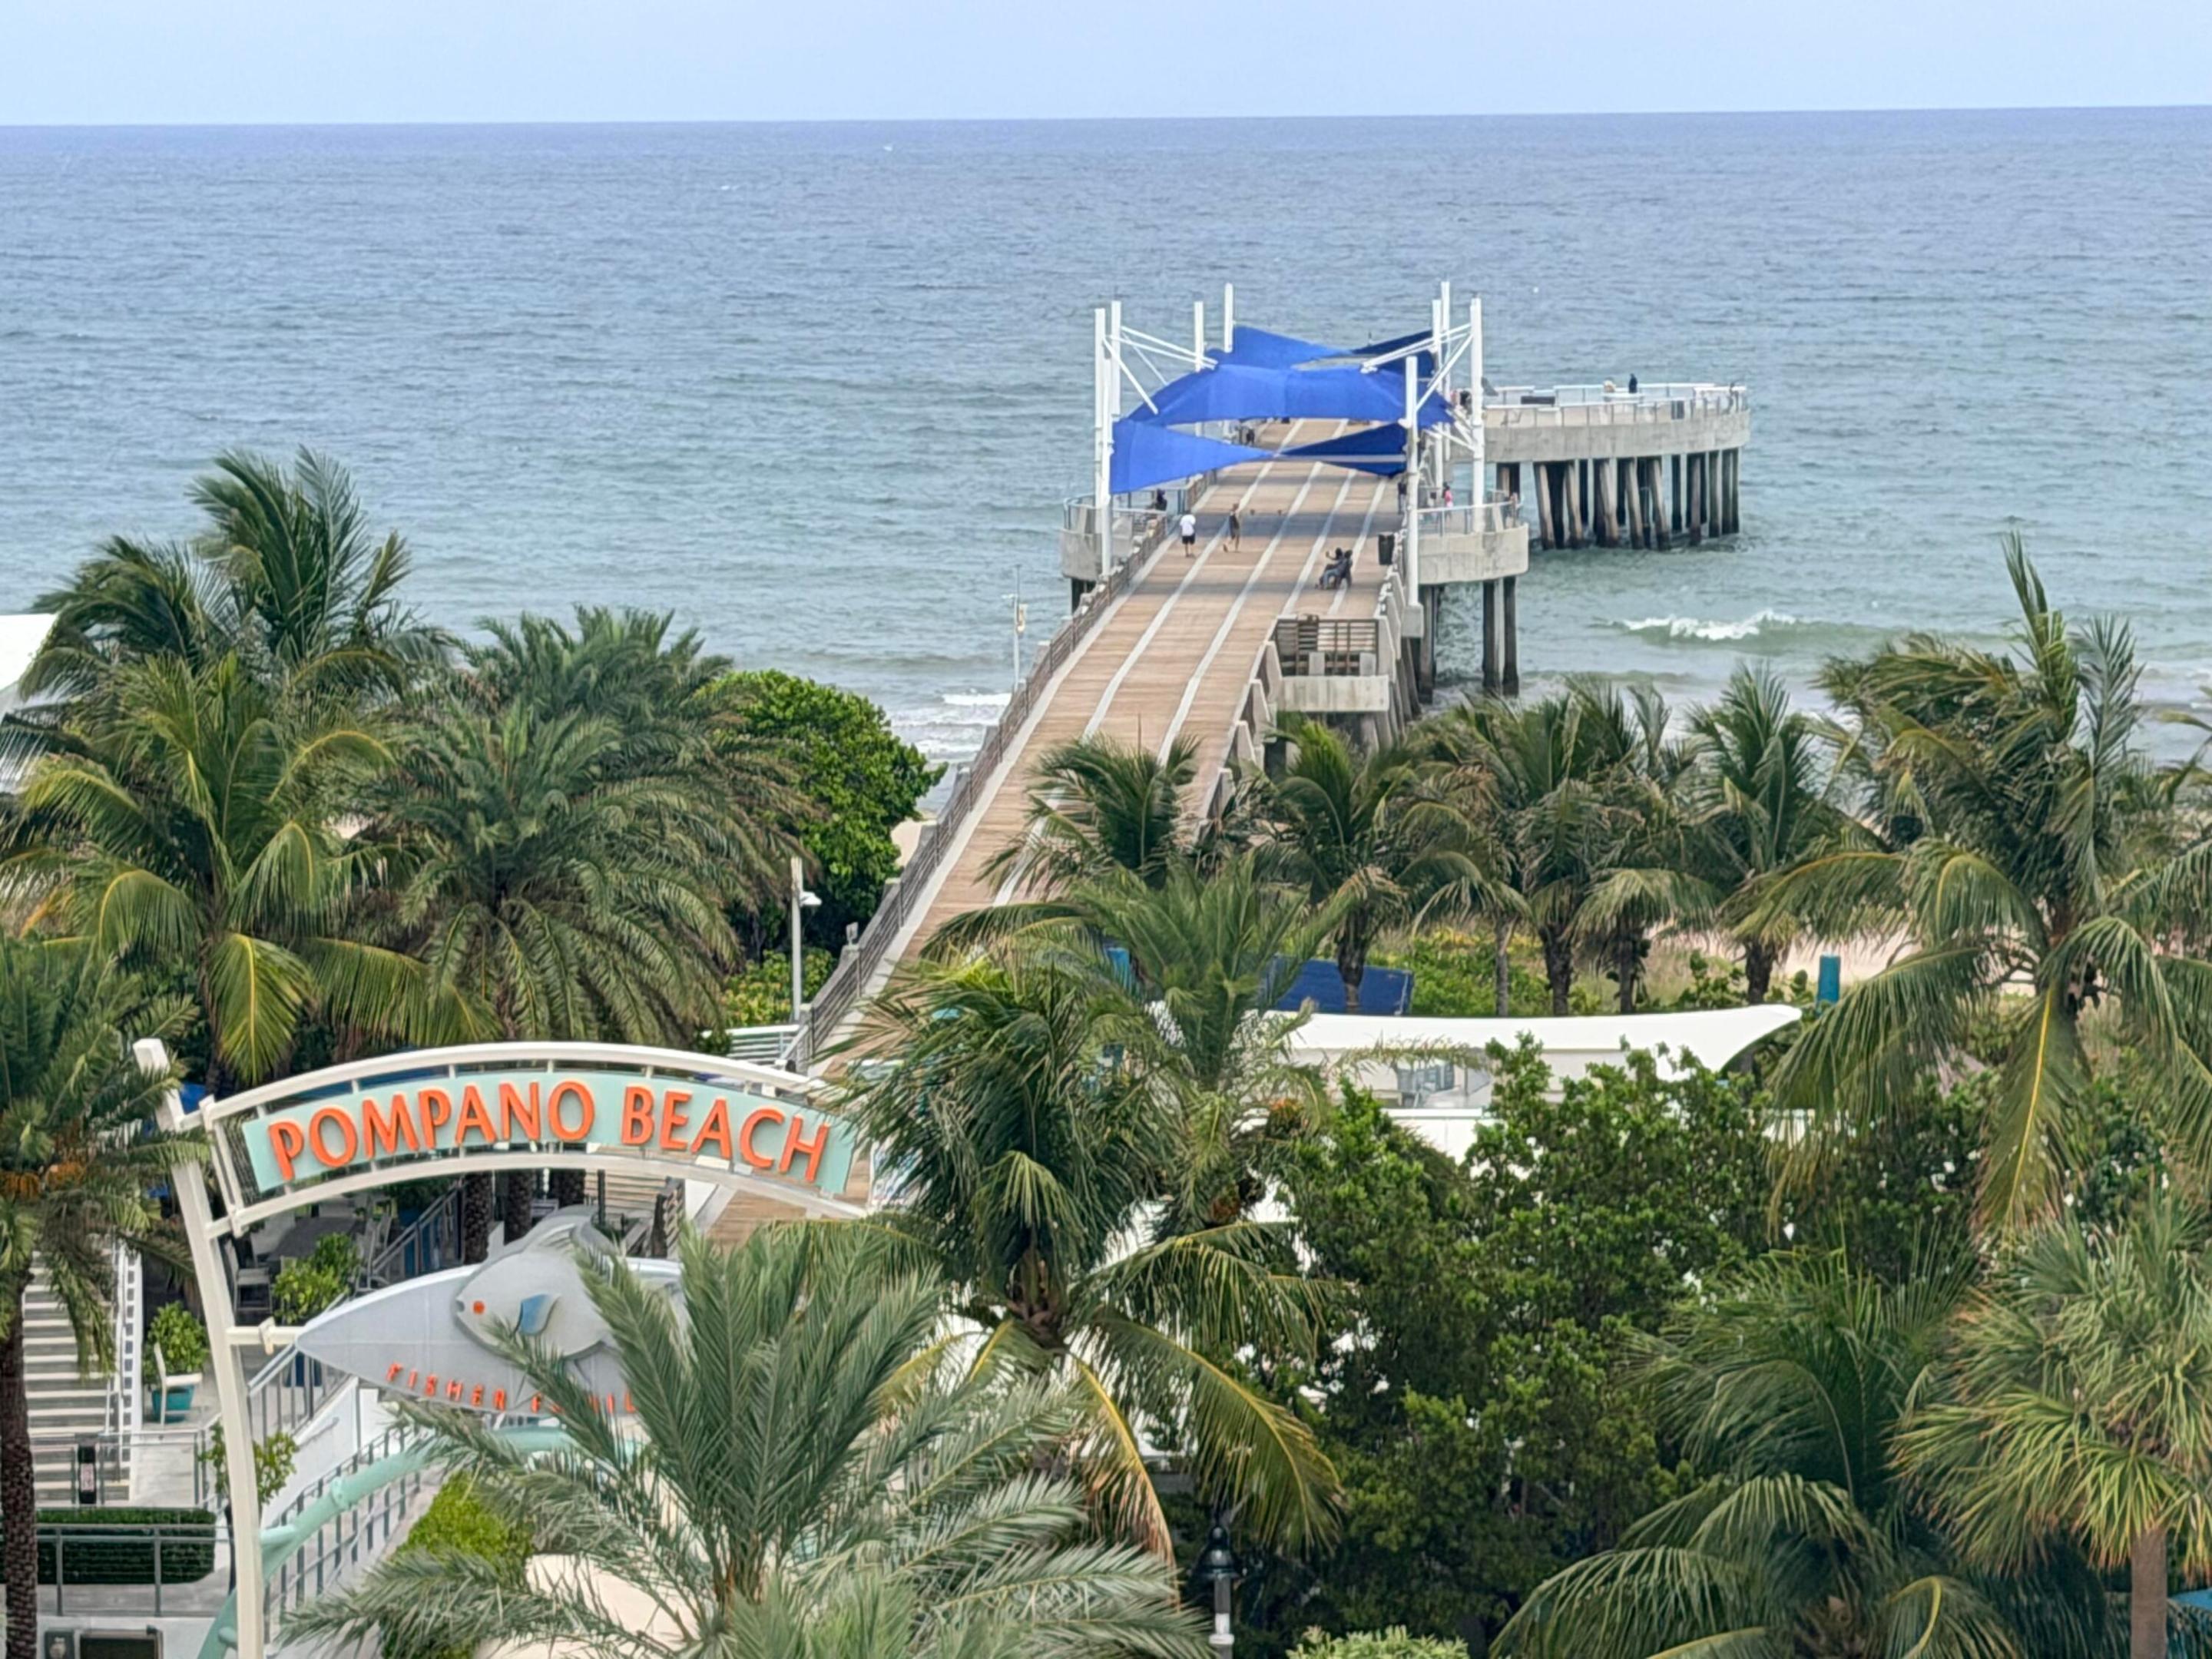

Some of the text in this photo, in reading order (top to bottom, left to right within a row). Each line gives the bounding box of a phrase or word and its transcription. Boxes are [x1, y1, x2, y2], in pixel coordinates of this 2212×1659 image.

[267, 1080, 830, 1184] POMPANO BEACH
[386, 1361, 508, 1412] FISHER
